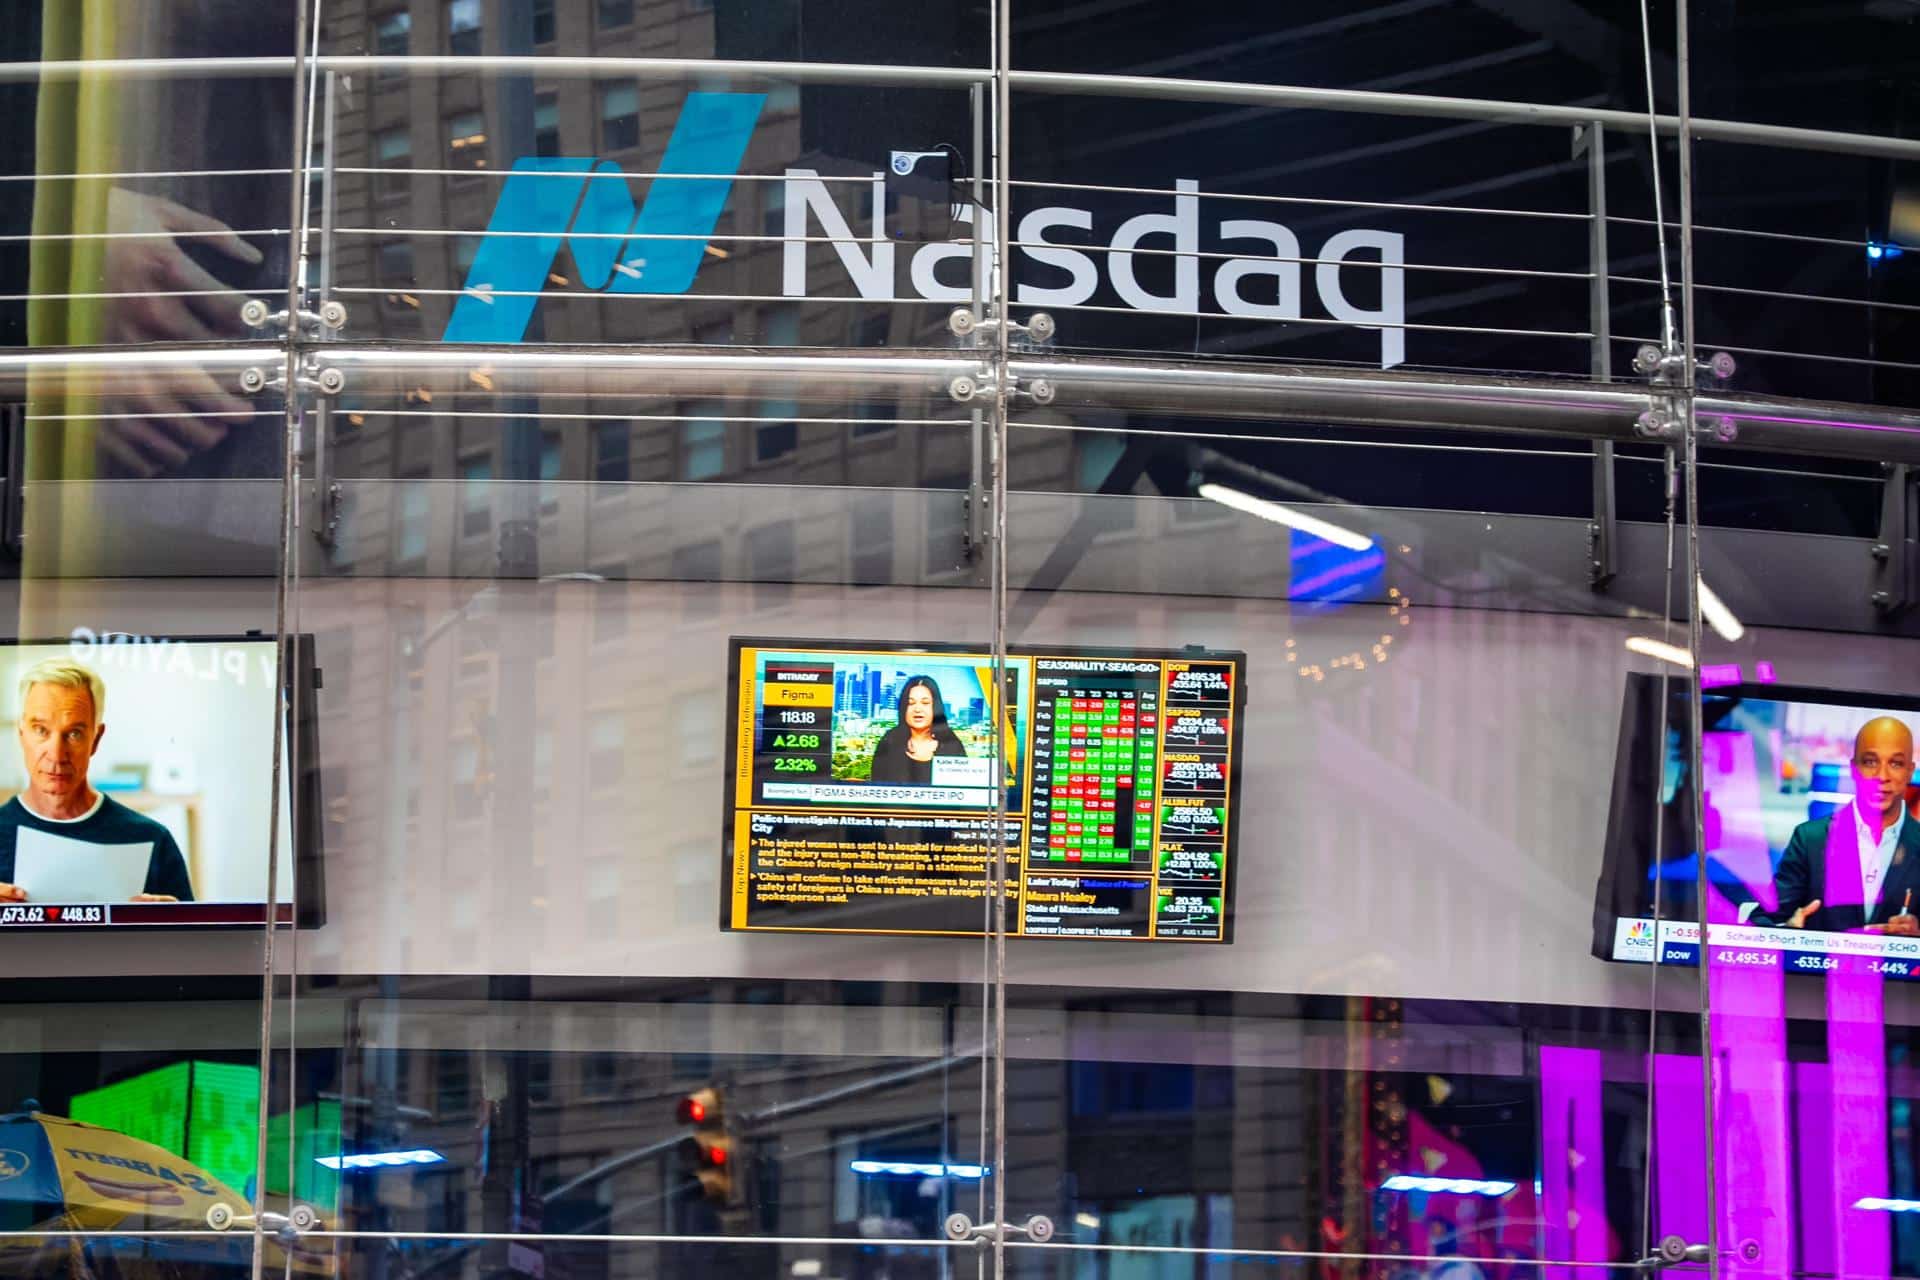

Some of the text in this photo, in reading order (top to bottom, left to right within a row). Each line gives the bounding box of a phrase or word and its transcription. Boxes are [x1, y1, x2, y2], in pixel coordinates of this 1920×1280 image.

[1168, 664, 1189, 672] DOW
[777, 673, 819, 682] INTRADAY
[1176, 672, 1222, 682] 43495.34
[782, 689, 814, 700] Figma
[780, 711, 815, 724] 118.18
[1036, 712, 1051, 720] Feb
[1178, 718, 1217, 726] 6234.42
[786, 734, 819, 748] 2.68
[1164, 754, 1200, 762] NASDAQ
[774, 758, 817, 772] 2.32%
[1172, 763, 1218, 772] 20670.24
[815, 788, 965, 800] FIGMA SHARES POP AFTER IPO
[1173, 808, 1212, 816] 2565.50
[751, 814, 783, 824] Police
[784, 815, 838, 826] Investigate
[840, 816, 872, 826] Attack
[874, 818, 886, 826] on
[888, 818, 934, 828] Japanese
[971, 820, 980, 828] in
[751, 824, 774, 834] City
[759, 839, 774, 847] The
[776, 839, 806, 848] injured
[857, 842, 876, 850] sent
[877, 842, 887, 850] to
[896, 842, 929, 852] hospital
[930, 843, 943, 852] for
[944, 844, 978, 852] medical
[1160, 844, 1184, 852] PLAT.
[758, 848, 775, 857] and
[777, 849, 792, 858] the
[794, 850, 819, 860] injury
[841, 850, 876, 859] non-life
[877, 852, 932, 862] threatening,
[1006, 856, 1020, 864] for
[1172, 852, 1210, 861] 1304.92
[758, 858, 774, 866] the
[776, 859, 816, 868] Chinese
[816, 860, 852, 870] foreign
[853, 861, 892, 871] ministry
[894, 862, 914, 870] said
[916, 862, 926, 870] in
[935, 864, 986, 872] statement.
[786, 873, 802, 882] will
[803, 874, 841, 882] continue
[842, 874, 852, 883] to
[854, 874, 873, 884] take
[874, 875, 914, 885] effective
[915, 878, 958, 886] measures
[959, 878, 968, 886] to
[1004, 878, 1019, 887] the
[1028, 878, 1050, 887] Later
[1051, 878, 1076, 888] Today
[756, 882, 785, 892] safety
[786, 884, 796, 892] of
[798, 884, 844, 894] foreigners
[845, 884, 854, 893] in
[856, 885, 882, 894] China
[932, 887, 948, 896] the
[949, 888, 981, 898] foreign
[756, 892, 849, 902] spokesperson said.
[1027, 891, 1059, 902] Maura
[1060, 892, 1096, 904] Healey
[1174, 896, 1203, 906] 20.35
[1026, 904, 1120, 914] State of Massachusetts
[61, 907, 101, 922] 448.83
[1026, 915, 1060, 923] Governor
[1626, 937, 1655, 947] CNBC
[1726, 931, 1918, 953] Schwab Short Term Us Treasury SCHO
[1666, 950, 1908, 974] DOW 43,495.34 -635.64 -1.44%
